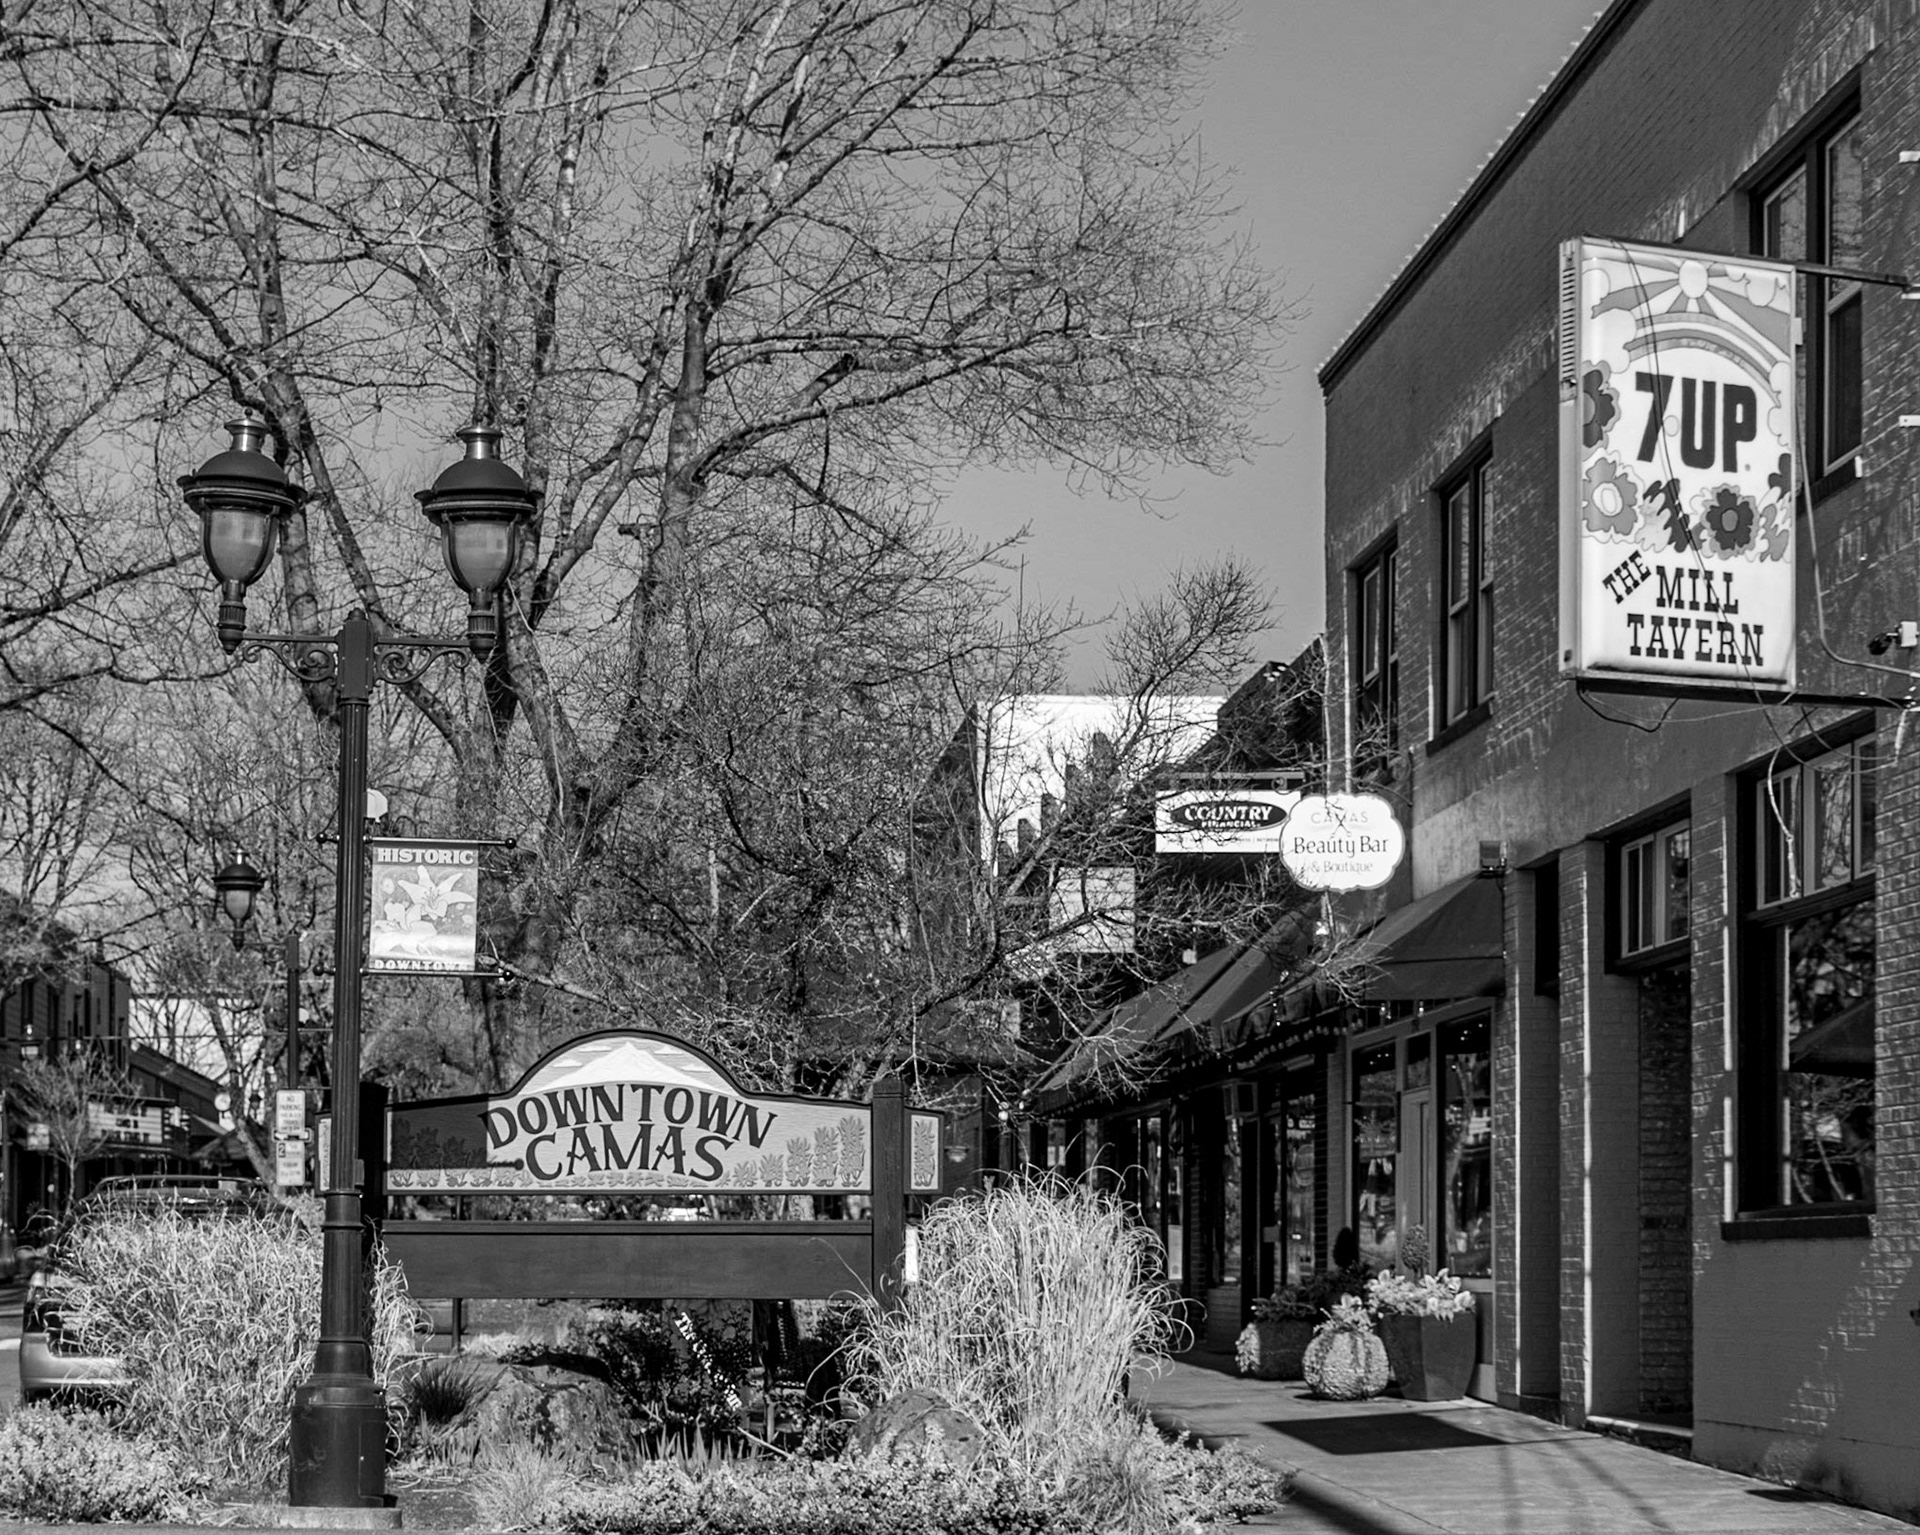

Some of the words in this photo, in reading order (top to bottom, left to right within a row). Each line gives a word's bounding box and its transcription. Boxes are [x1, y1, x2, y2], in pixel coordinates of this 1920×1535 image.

[1636, 371, 1757, 473] 7UP
[1602, 550, 1652, 604] THE
[1656, 565, 1739, 614] MILL
[1627, 613, 1764, 666] TAVERN
[1184, 806, 1273, 821] COUNTRY
[377, 848, 474, 865] HISTORIC
[1294, 836, 1355, 858] Beauty
[1360, 835, 1389, 852] Bar
[1311, 860, 1320, 872] &
[1324, 860, 1374, 875] Boutique
[477, 1084, 778, 1150] DOWNTOWN
[525, 1124, 734, 1181] CAMAS
